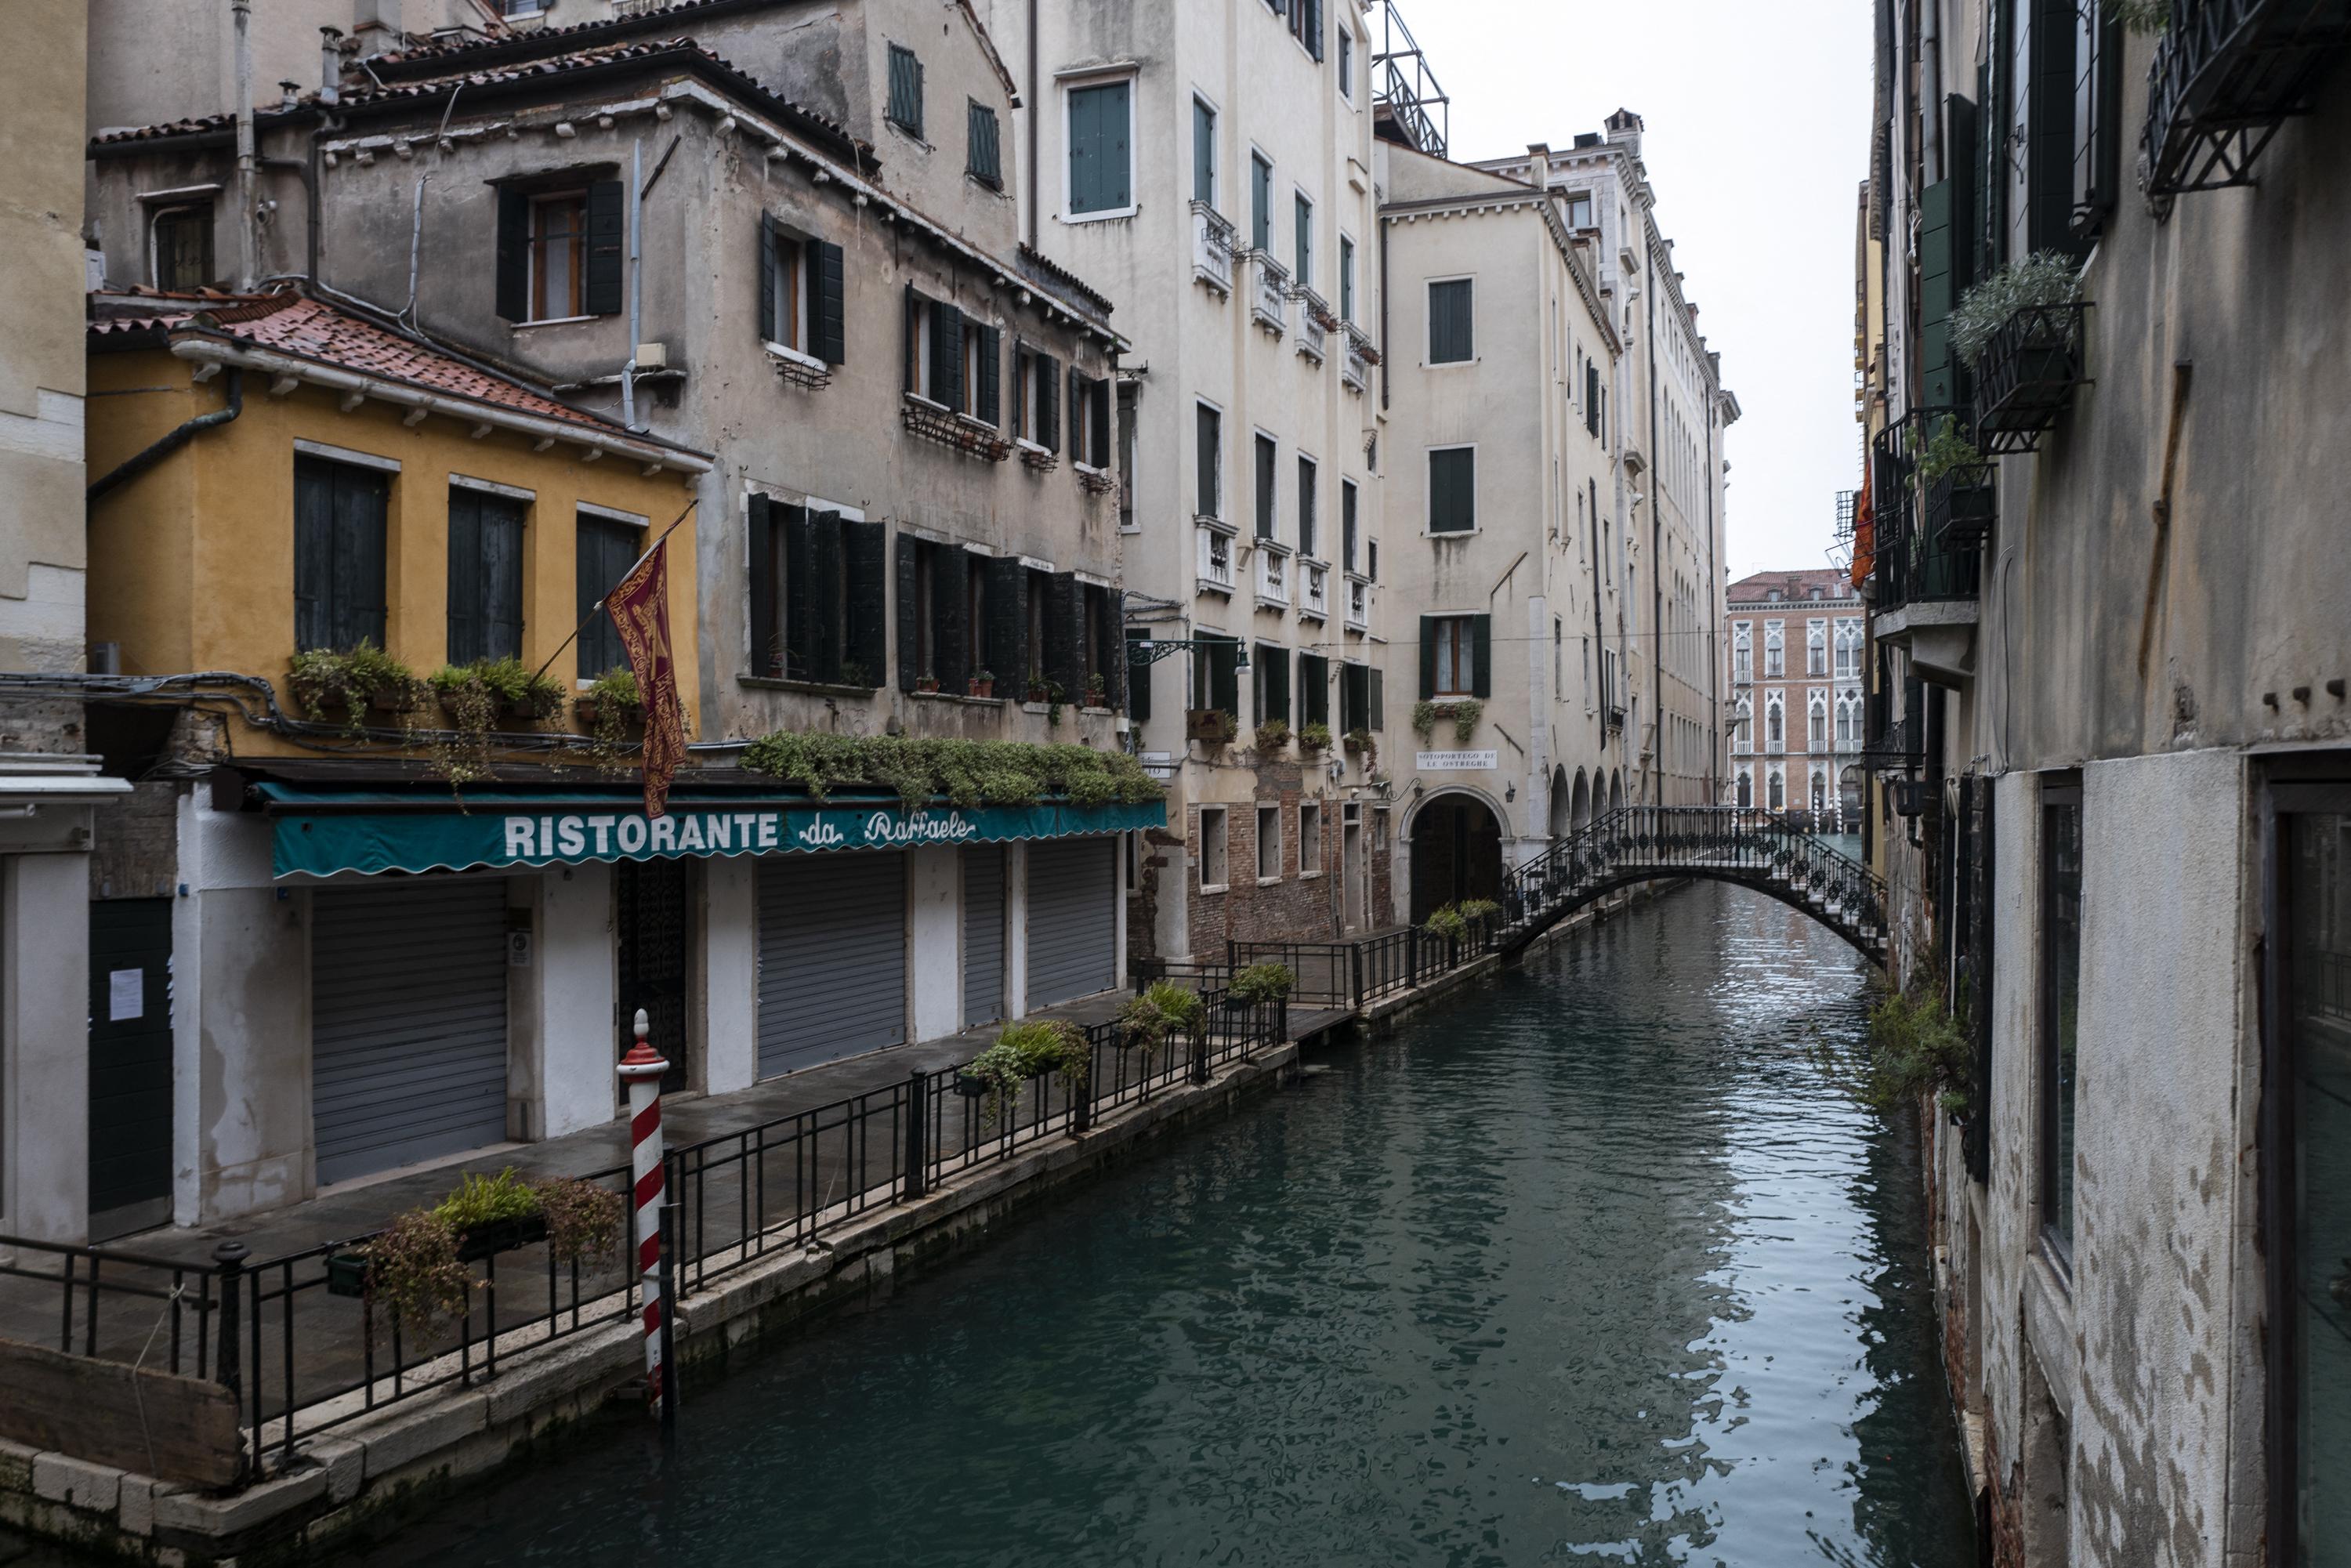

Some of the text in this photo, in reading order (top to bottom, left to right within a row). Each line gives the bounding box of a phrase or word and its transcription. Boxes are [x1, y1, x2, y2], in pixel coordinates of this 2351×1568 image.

[505, 810, 976, 856] RISTORANTE da Raffaele
